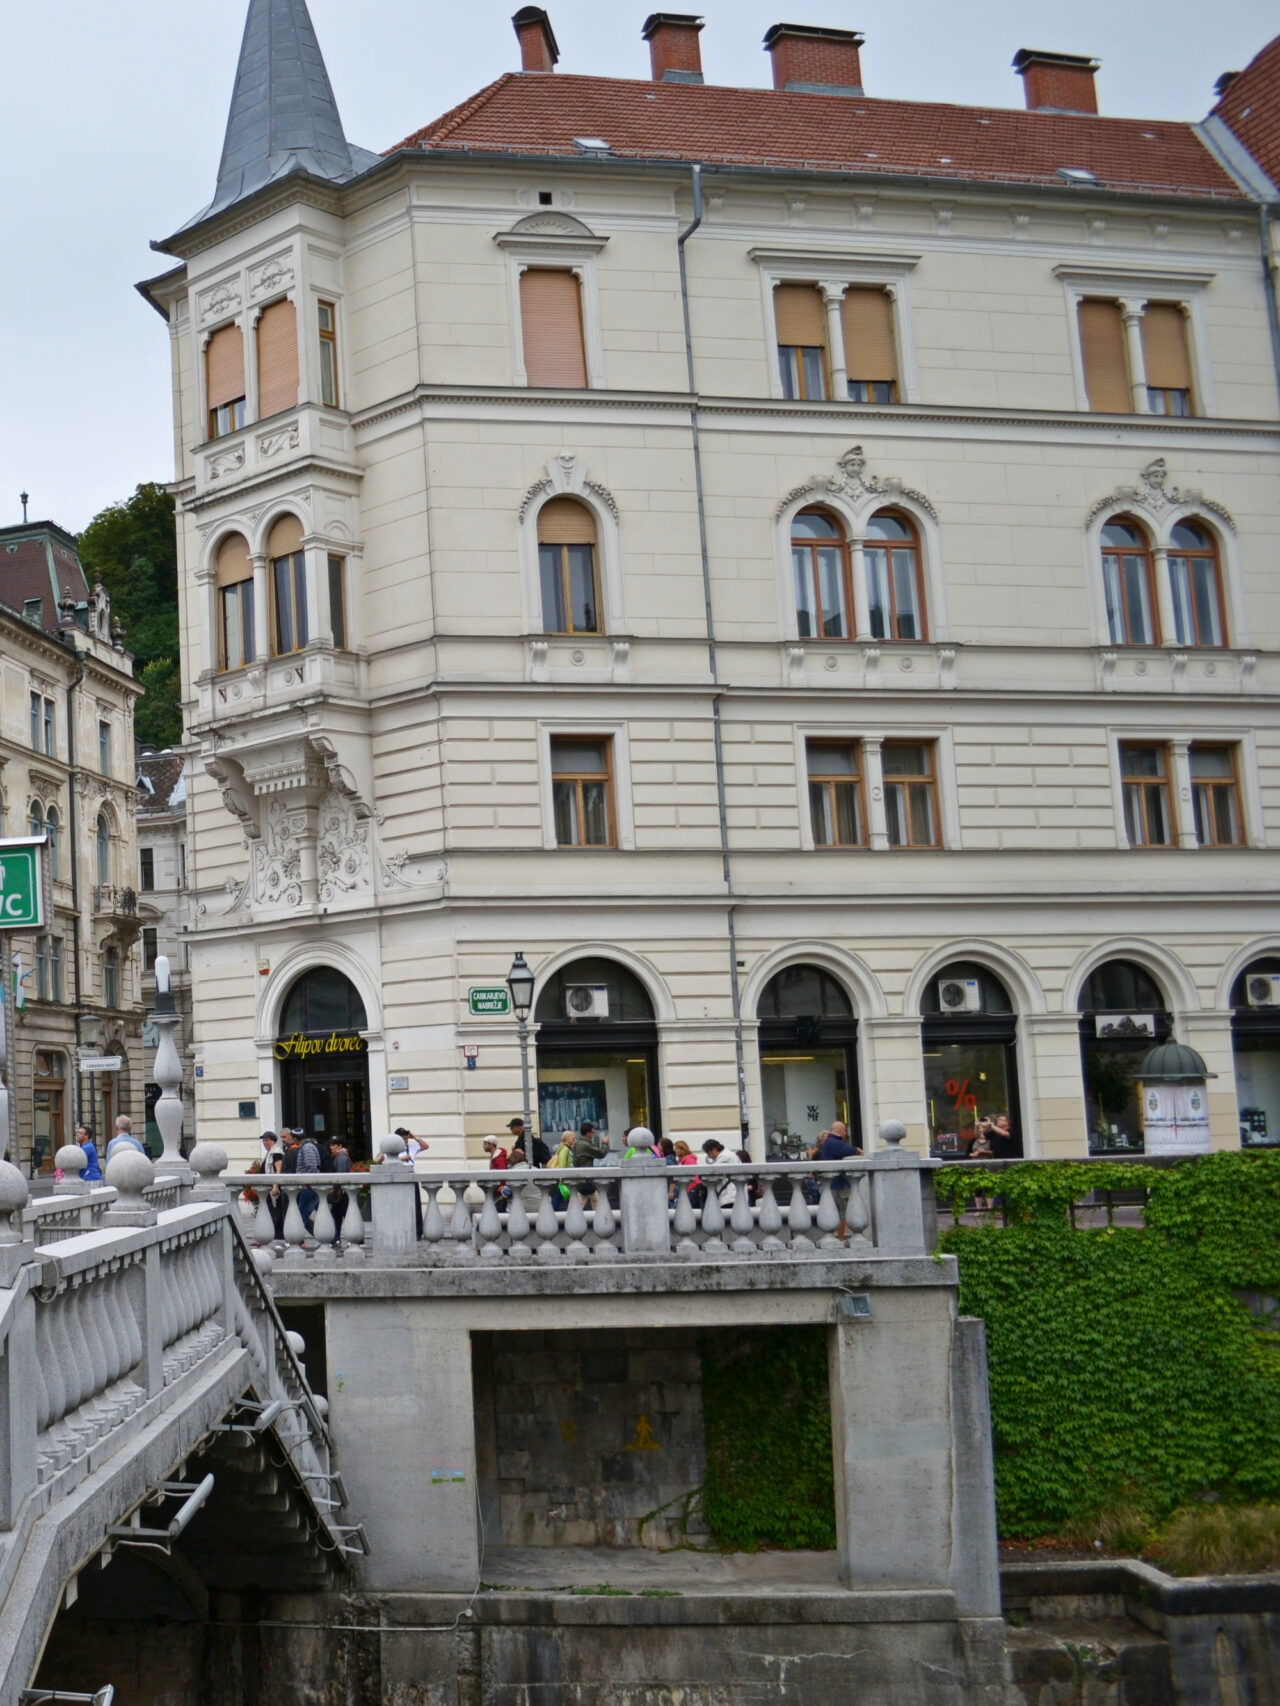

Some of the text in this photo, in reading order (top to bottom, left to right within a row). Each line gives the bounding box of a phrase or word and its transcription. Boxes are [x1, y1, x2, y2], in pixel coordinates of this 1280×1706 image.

[473, 992, 506, 1000] CANKARJEVO
[273, 1031, 364, 1060] Filipov dvorec
